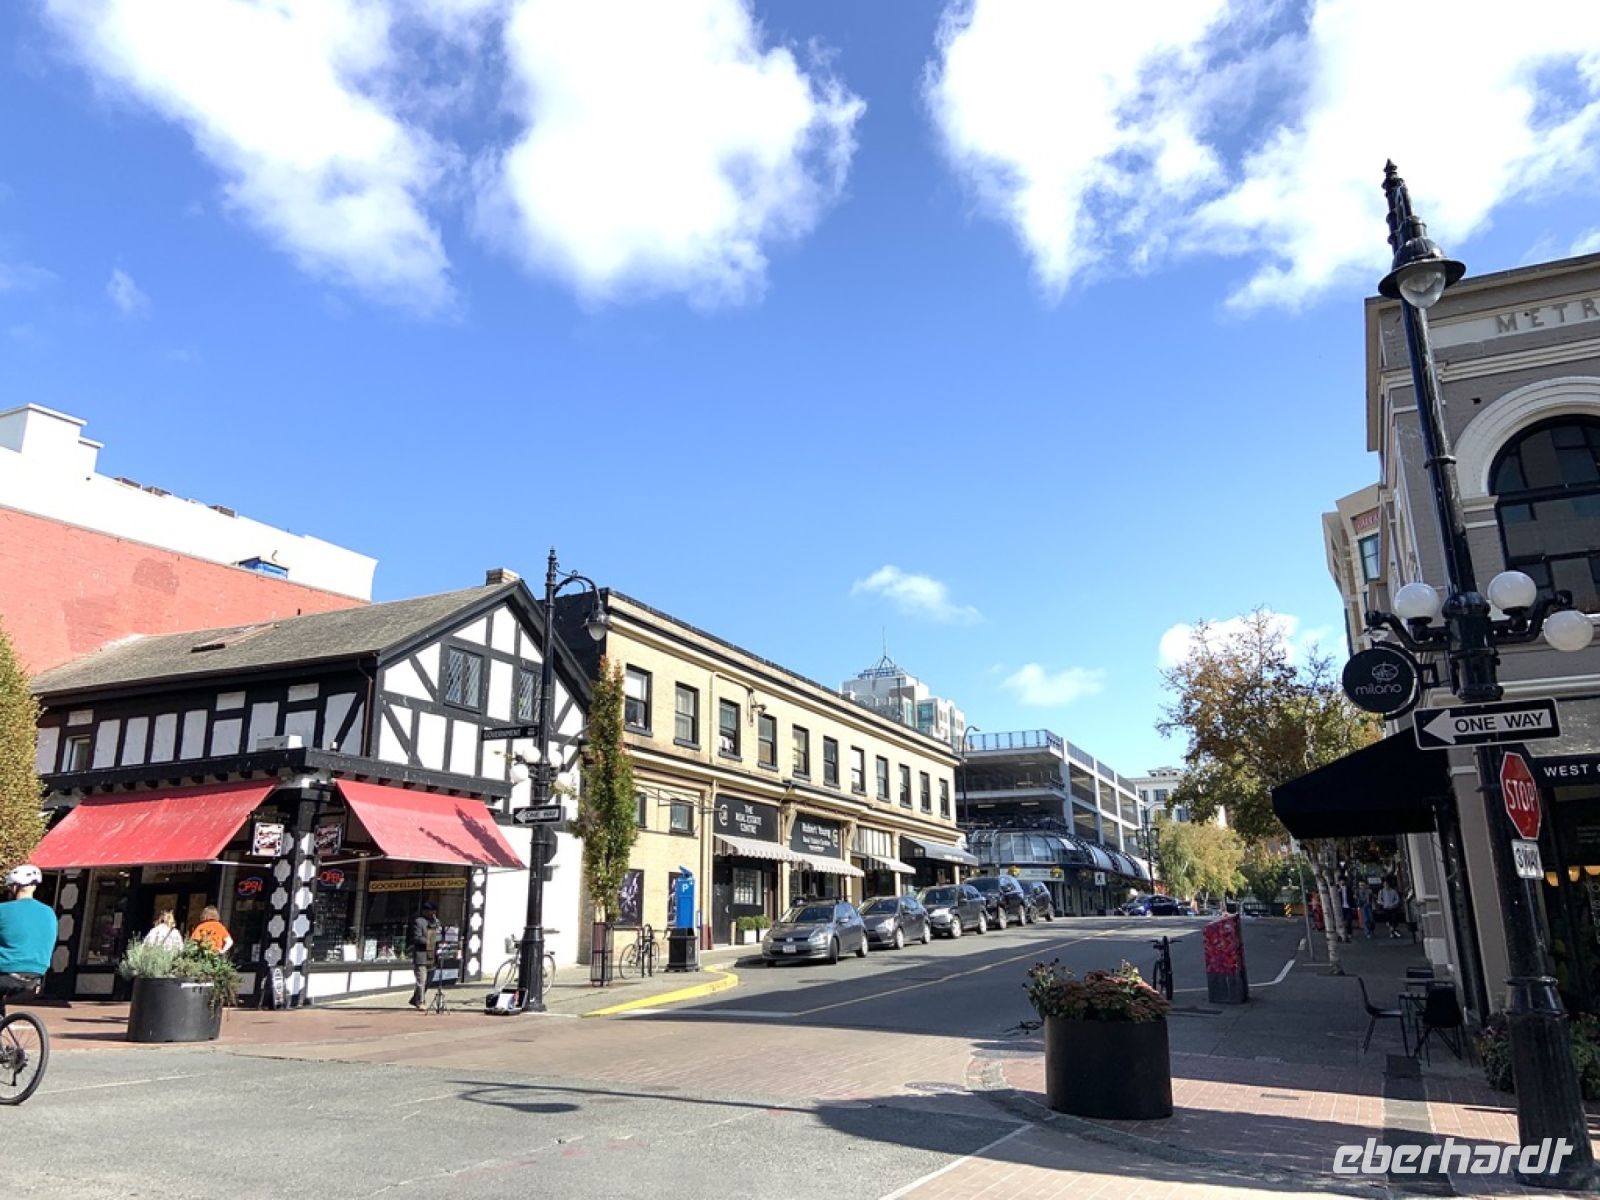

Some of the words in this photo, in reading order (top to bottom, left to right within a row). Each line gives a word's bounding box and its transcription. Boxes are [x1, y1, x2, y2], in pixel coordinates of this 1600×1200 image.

[1355, 682, 1402, 695] milano
[1454, 717, 1496, 734] ONE
[1504, 712, 1544, 728] WAY
[1543, 763, 1589, 777] WEST
[1505, 779, 1536, 812] STOP
[544, 808, 557, 816] WAY
[371, 882, 421, 890] GOODFELLAS
